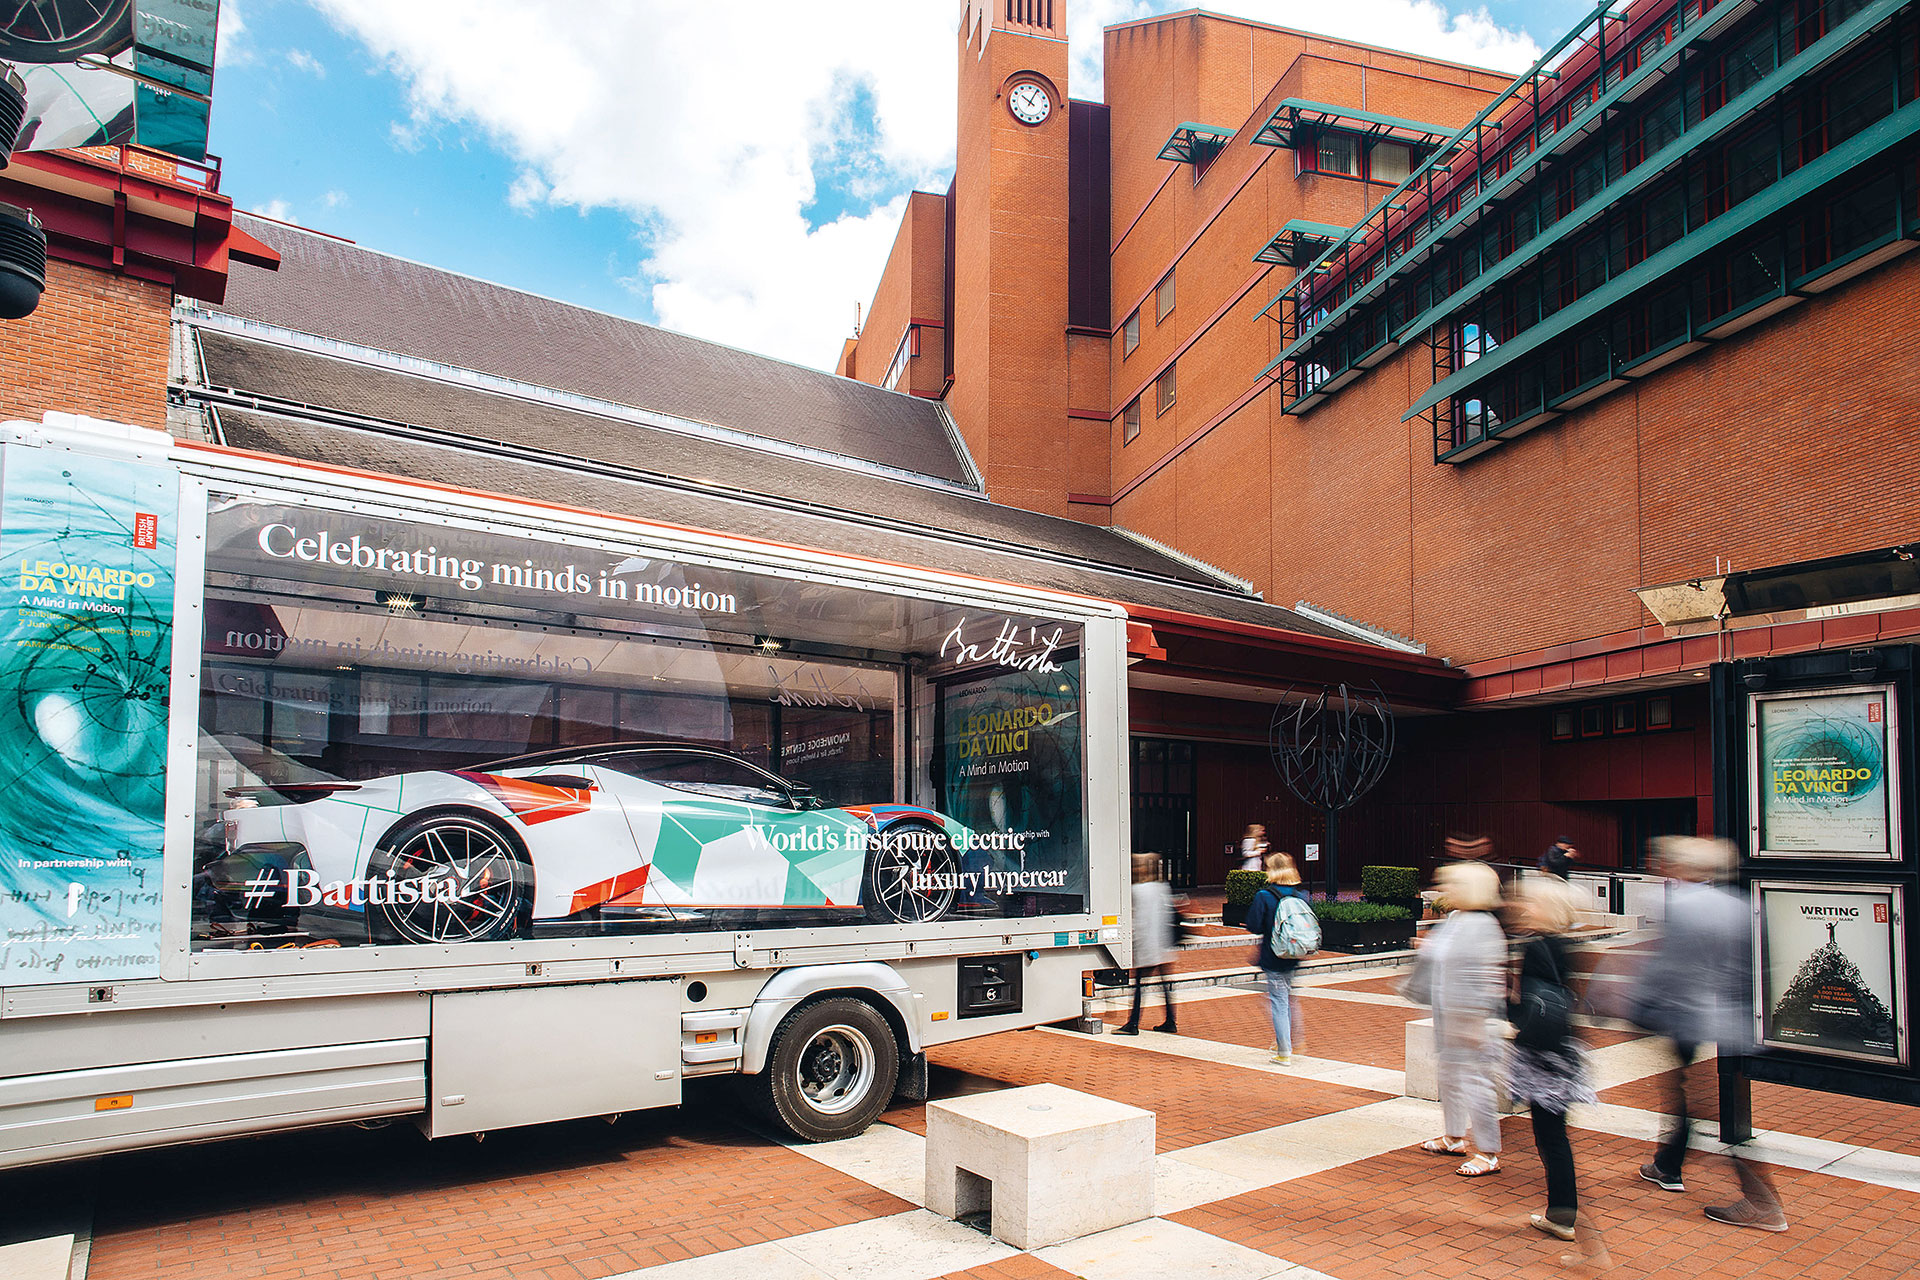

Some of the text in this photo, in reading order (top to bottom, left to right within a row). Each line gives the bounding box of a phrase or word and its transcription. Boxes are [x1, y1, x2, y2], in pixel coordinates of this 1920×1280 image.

[24, 497, 54, 505] LEONARDO
[138, 518, 147, 546] BRITISH
[146, 516, 154, 544] LIBRARY
[21, 559, 155, 588] LEONARDO
[258, 523, 484, 590] Celebrating
[490, 559, 592, 594] minds
[598, 569, 628, 600] in
[635, 582, 737, 614] motion
[19, 575, 125, 600] DA VINCI
[19, 595, 125, 614] A Mind in Motion
[27, 620, 51, 628] June
[129, 628, 151, 638] 2019
[940, 616, 1063, 673] Battista
[959, 686, 987, 698] LEONARDO
[959, 703, 1053, 737] LEONARDO
[959, 729, 1029, 759] DA VINCI
[958, 759, 1029, 777] A Mind in Motion
[1773, 768, 1872, 782] LEONARDO
[1773, 780, 1848, 794] DA VINCI
[1774, 796, 1781, 804] A
[1783, 796, 1804, 804] Mind
[1816, 795, 1849, 804] Motion
[844, 825, 890, 851] first
[895, 832, 947, 858] pure
[951, 827, 1025, 851] electric
[1036, 829, 1050, 838] with
[18, 858, 132, 869] In partnership with
[911, 865, 1068, 897] luxury hypercar
[1800, 905, 1859, 917] WRITING
